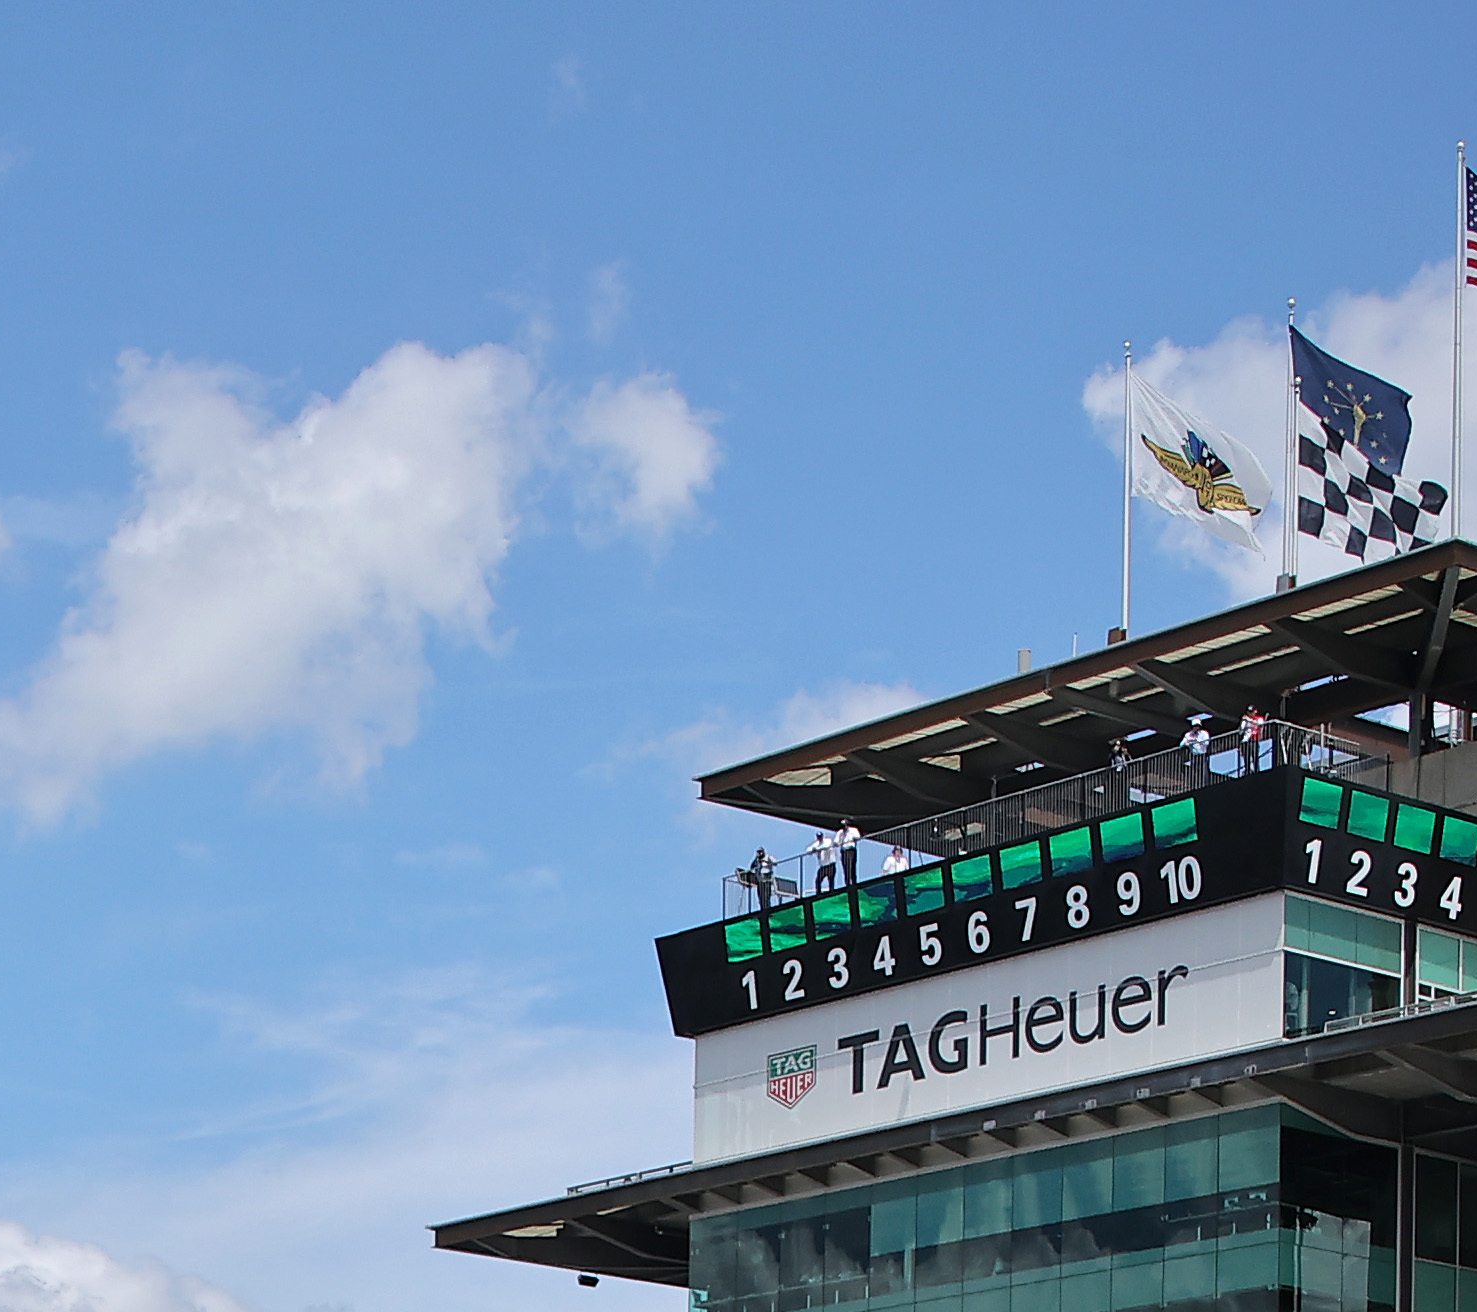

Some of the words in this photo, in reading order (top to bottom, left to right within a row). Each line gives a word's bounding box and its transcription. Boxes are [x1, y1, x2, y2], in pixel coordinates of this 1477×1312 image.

[1305, 840, 1321, 884] 1
[1347, 850, 1369, 897] 2
[1394, 862, 1419, 908] 3
[1439, 875, 1462, 921] 4
[741, 971, 758, 1010] 1
[782, 960, 805, 1001] 2
[827, 947, 849, 989] 3
[873, 935, 896, 977] 4
[919, 923, 942, 966] 5
[967, 910, 990, 954] 6
[1015, 897, 1038, 942] 7
[1066, 884, 1091, 929] 8
[1116, 871, 1142, 917] 9
[1159, 855, 1203, 904] 10
[769, 1071, 815, 1102] HEUER
[770, 1050, 814, 1077] TAG
